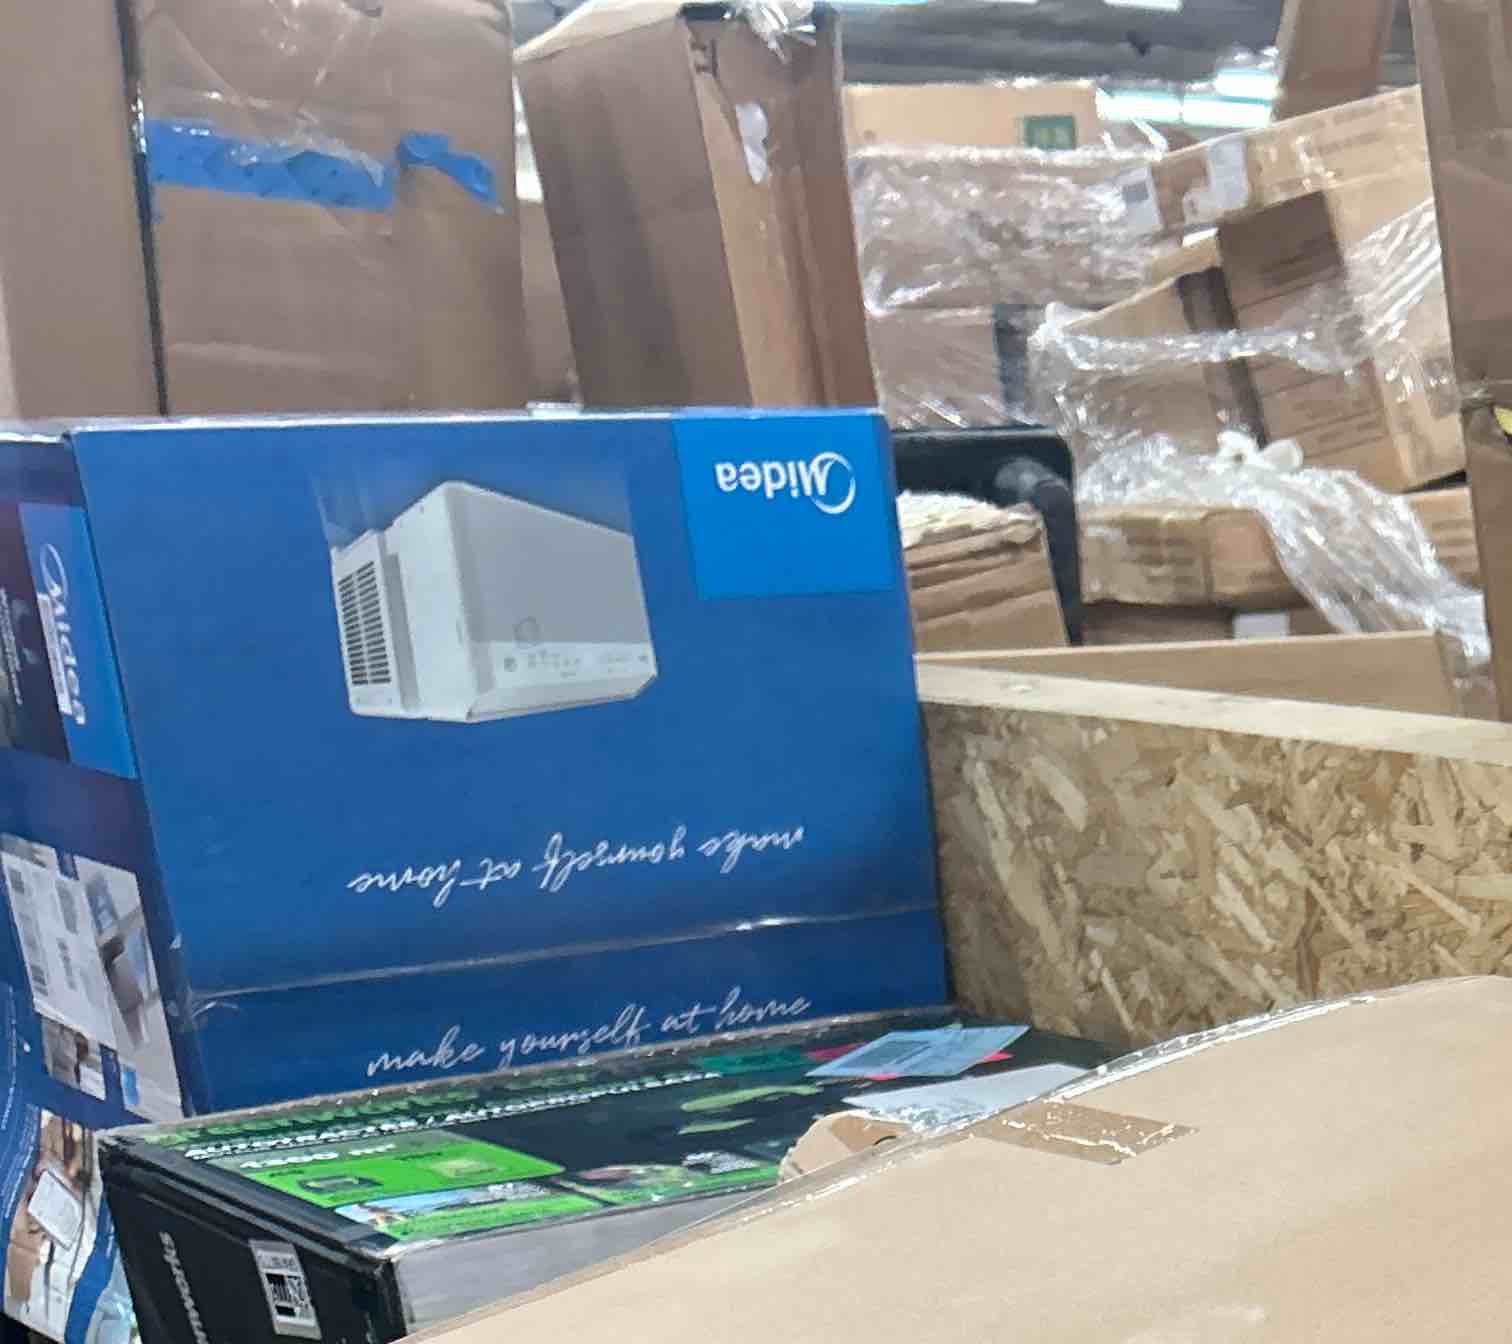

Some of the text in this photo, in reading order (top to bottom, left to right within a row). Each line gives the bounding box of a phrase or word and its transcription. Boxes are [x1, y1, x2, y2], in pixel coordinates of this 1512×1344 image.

[714, 450, 858, 516] Midea
[346, 826, 804, 907] make yourself at home
[366, 986, 812, 1078] make yourself at home
